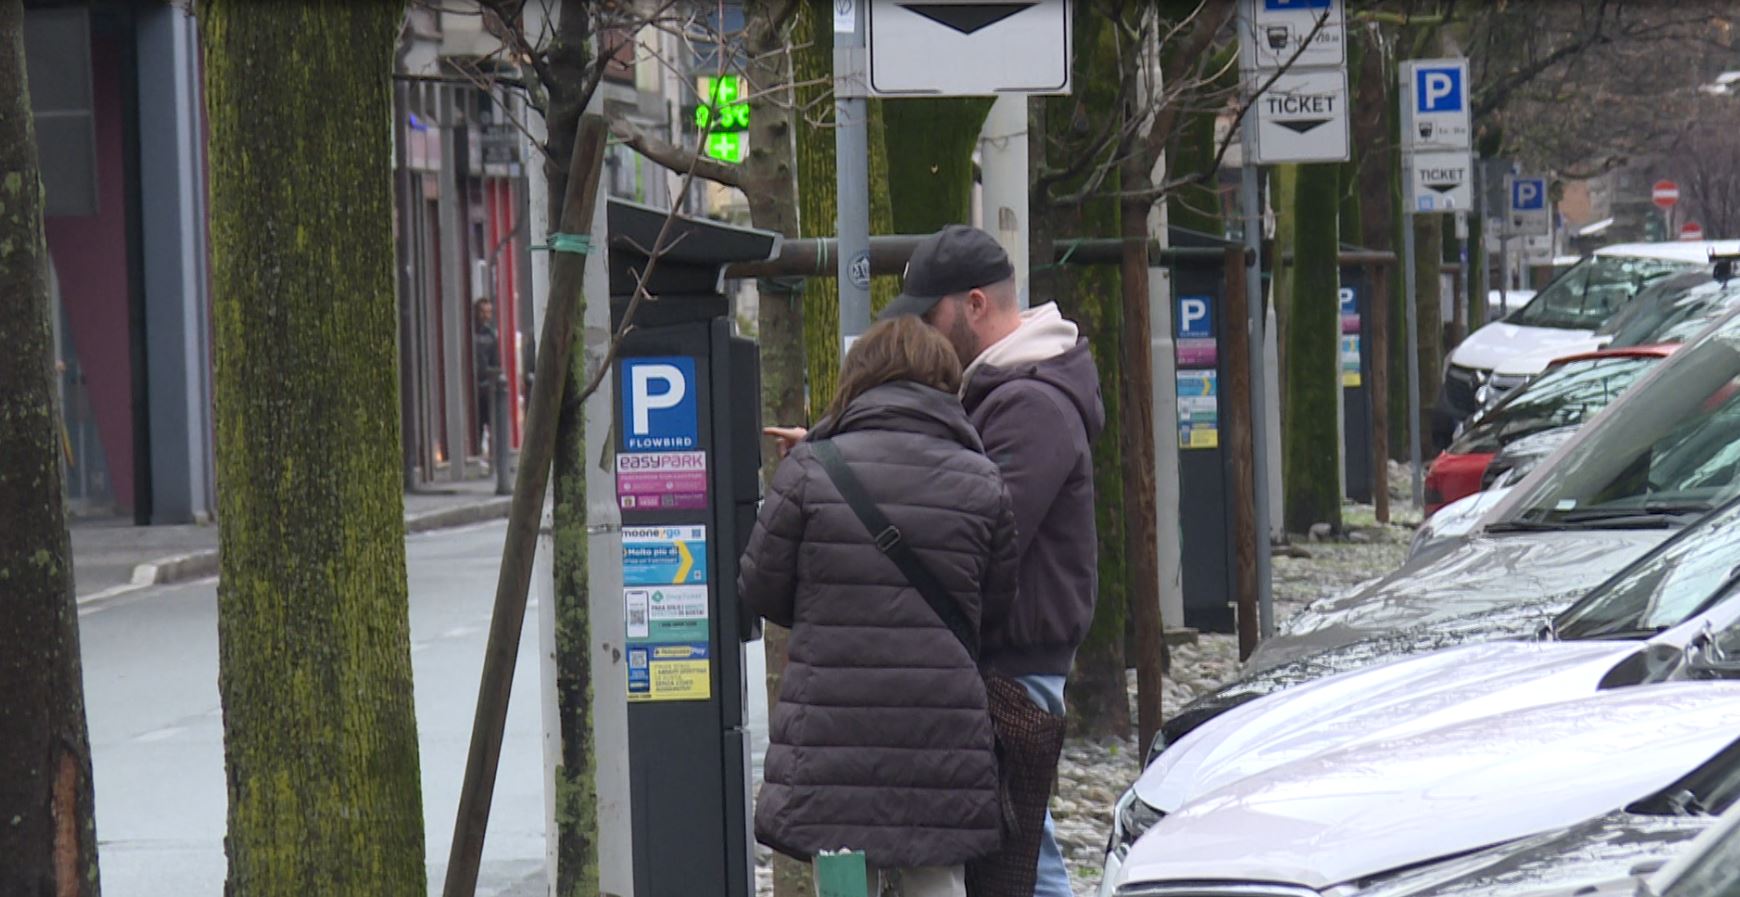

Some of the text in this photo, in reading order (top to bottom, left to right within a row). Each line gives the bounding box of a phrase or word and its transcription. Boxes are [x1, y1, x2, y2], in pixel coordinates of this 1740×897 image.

[1425, 72, 1453, 110] P
[1266, 96, 1336, 115] TICKET
[1419, 168, 1465, 181] TICKET
[1518, 183, 1537, 208] P
[1181, 299, 1206, 332] P
[632, 364, 686, 435] P
[629, 437, 692, 448] FLOWBIRD
